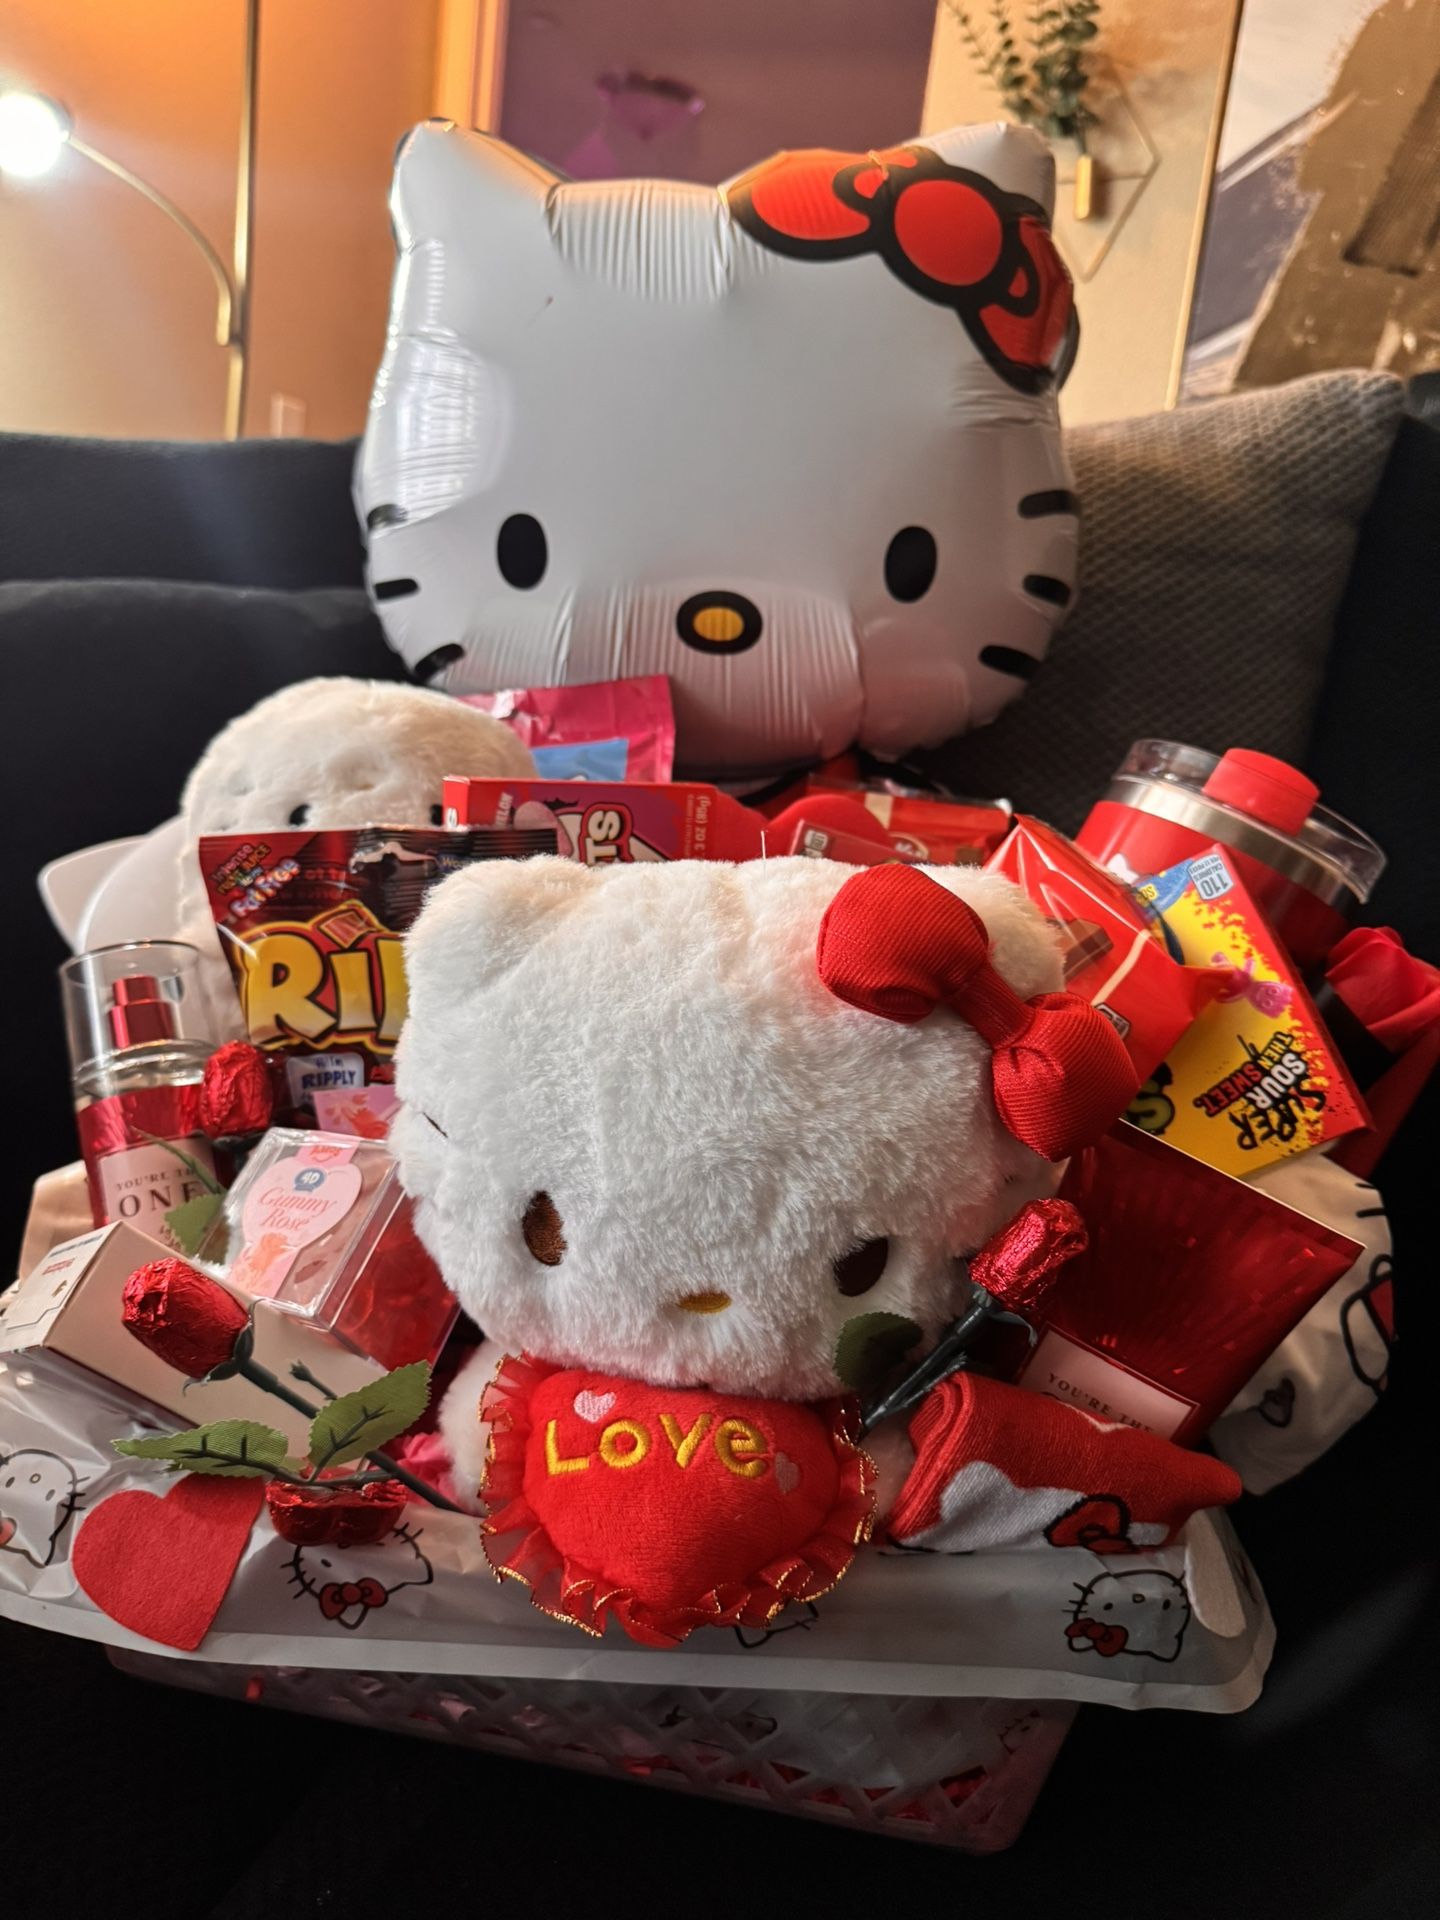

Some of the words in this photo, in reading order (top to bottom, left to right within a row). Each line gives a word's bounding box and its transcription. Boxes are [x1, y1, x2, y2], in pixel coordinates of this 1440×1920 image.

[1201, 873, 1228, 897] 110
[1252, 1031, 1293, 1072] THEN
[302, 1071, 356, 1089] RIPPLY
[1246, 1051, 1308, 1111] SOUR
[1229, 1080, 1327, 1152] SUPER
[116, 1172, 170, 1191] YOU'RE
[257, 1187, 338, 1218] Gummy
[260, 1208, 312, 1232] Rose
[1047, 1371, 1112, 1418] YOU'RE
[544, 1412, 769, 1479] Love
